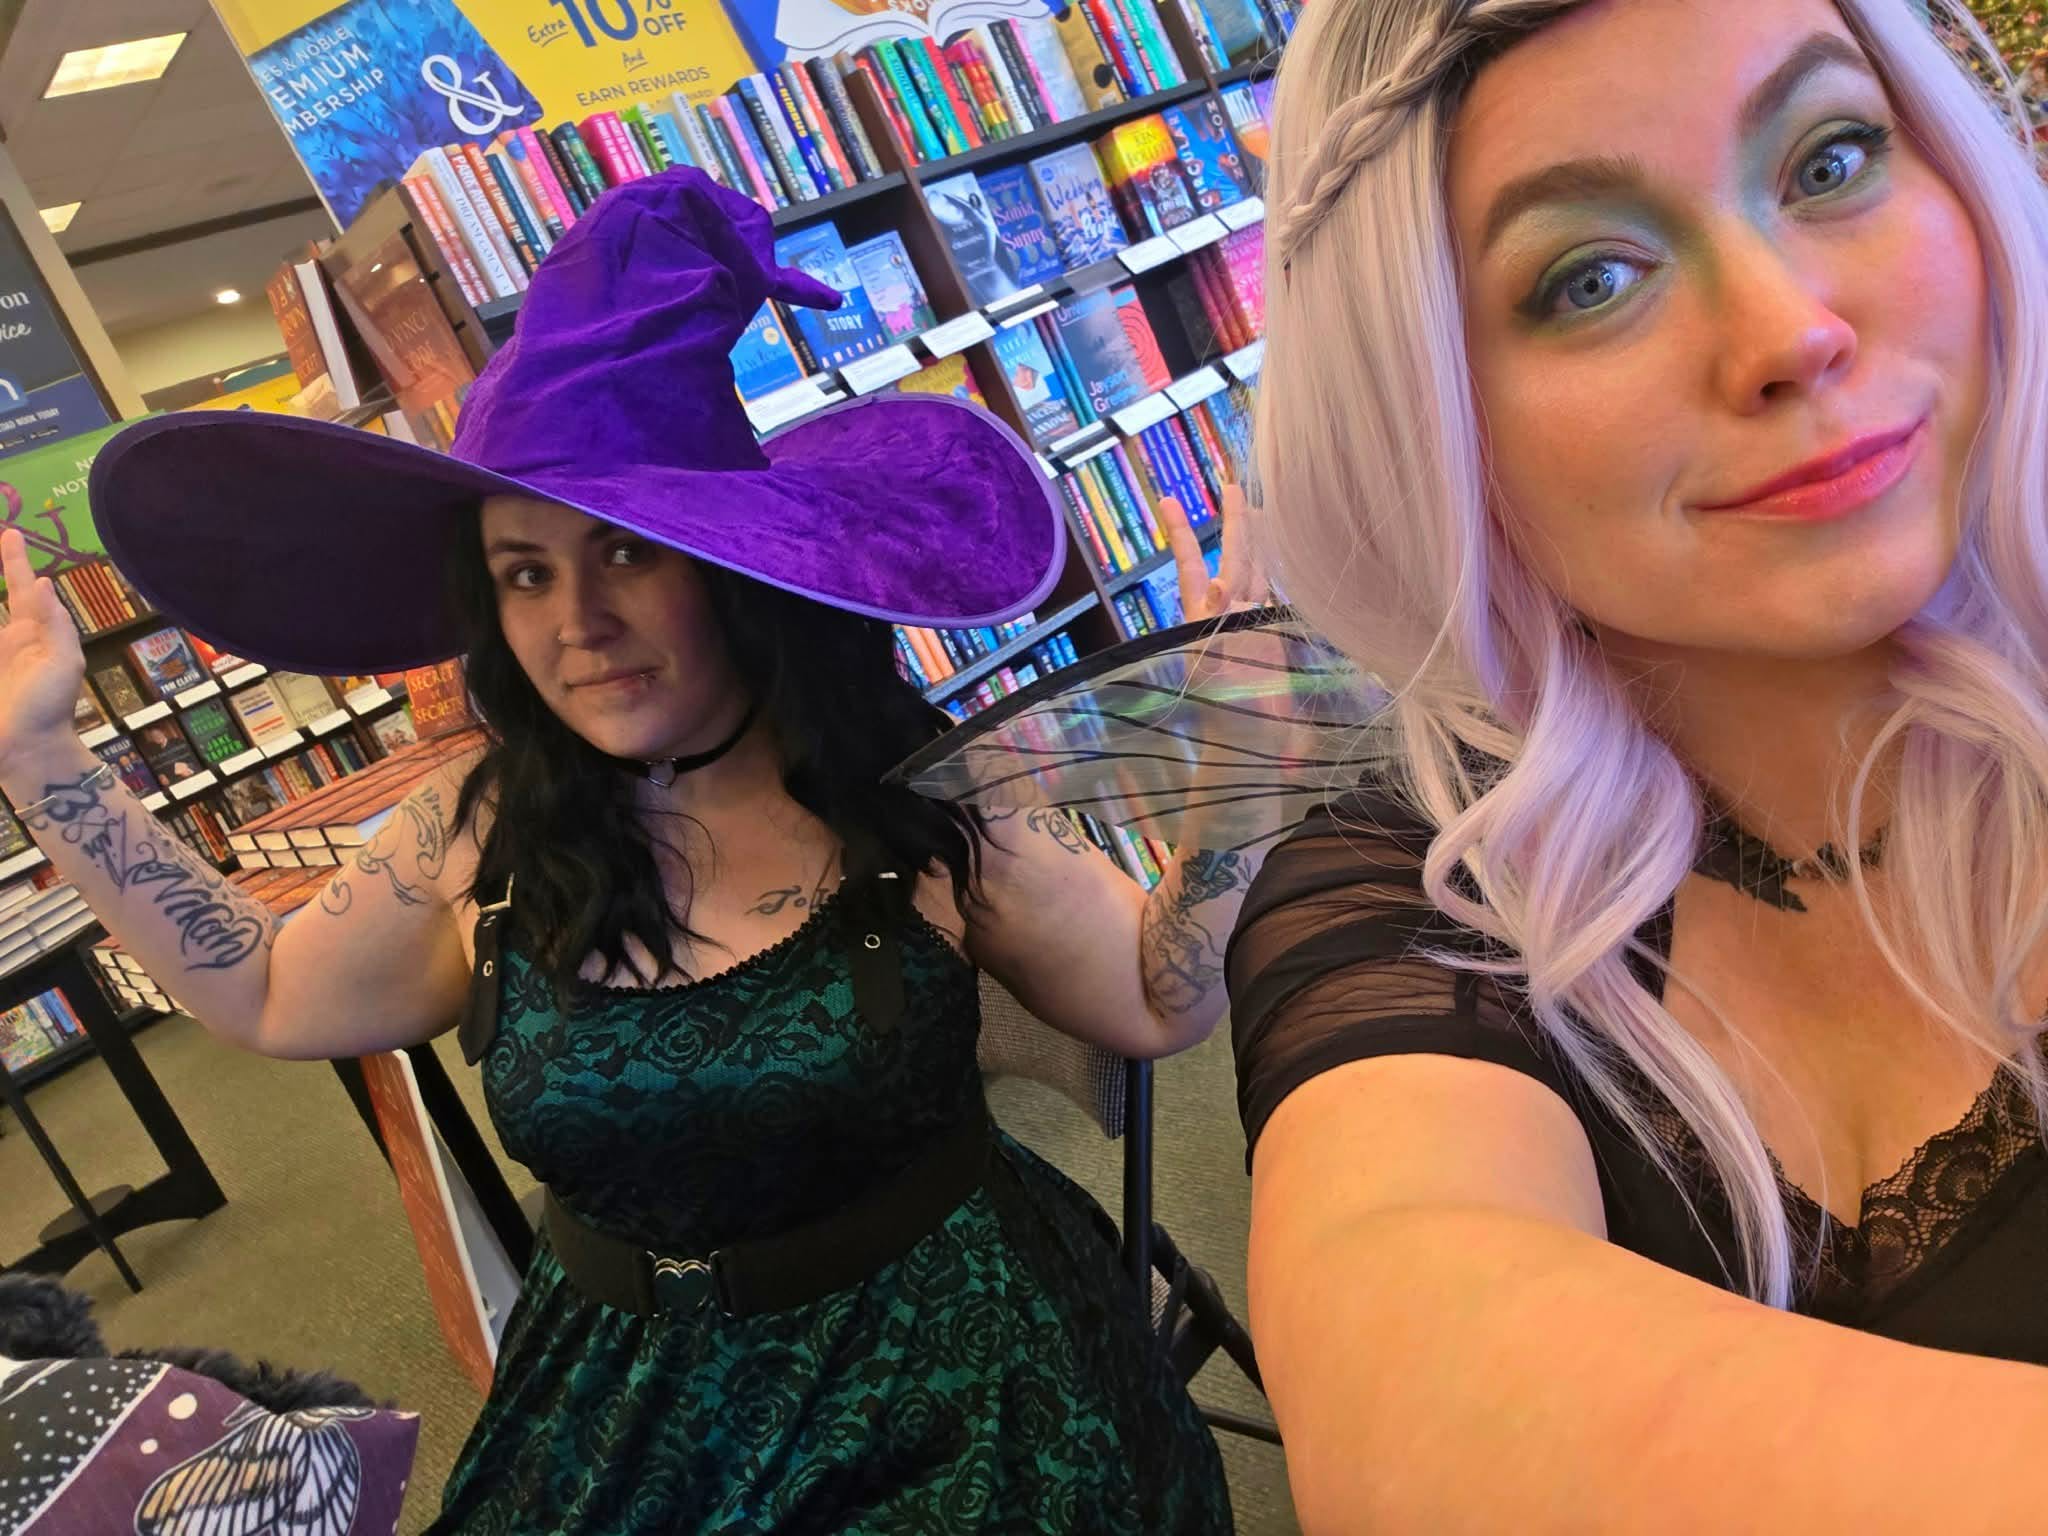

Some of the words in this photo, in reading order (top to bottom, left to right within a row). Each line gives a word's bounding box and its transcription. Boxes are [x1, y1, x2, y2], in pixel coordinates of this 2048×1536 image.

[527, 18, 567, 43] Extra
[643, 12, 687, 36] OFF
[270, 43, 370, 110] EMIUM
[576, 84, 627, 107] EARN
[627, 66, 710, 94] REWARDS
[827, 314, 865, 332] STORY
[410, 663, 456, 693] SECRET
[414, 697, 467, 724] SECRETS
